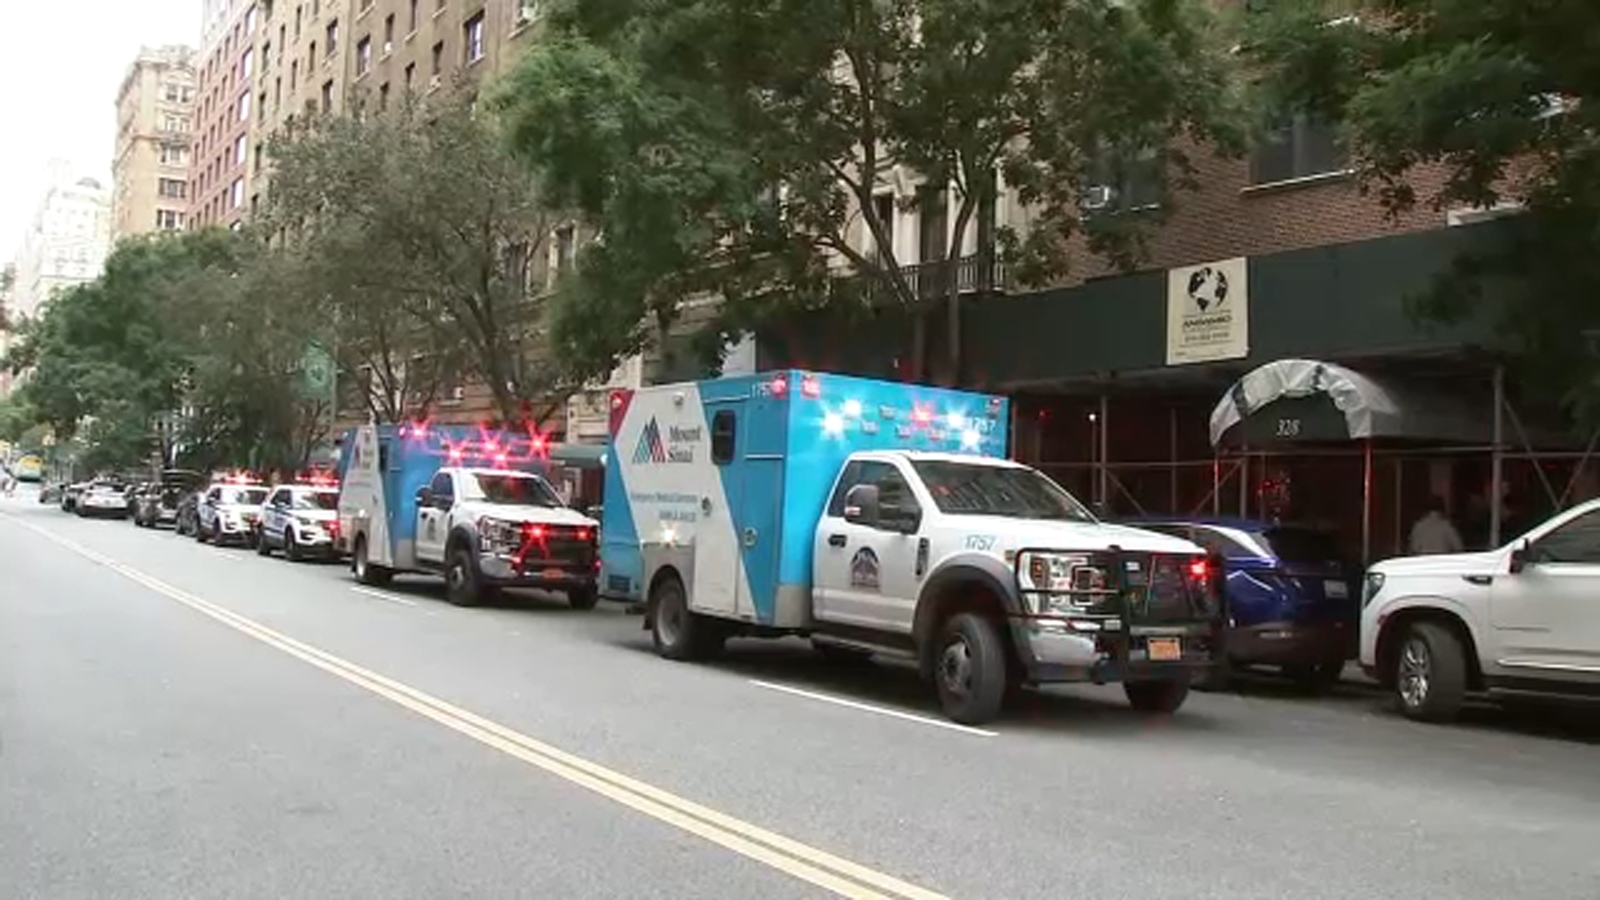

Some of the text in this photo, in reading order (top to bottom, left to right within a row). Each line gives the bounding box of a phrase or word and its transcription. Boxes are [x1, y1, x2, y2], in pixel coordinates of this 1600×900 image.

[669, 426, 701, 442] Mount
[668, 447, 693, 463] Sinai
[965, 535, 996, 551] 1757
